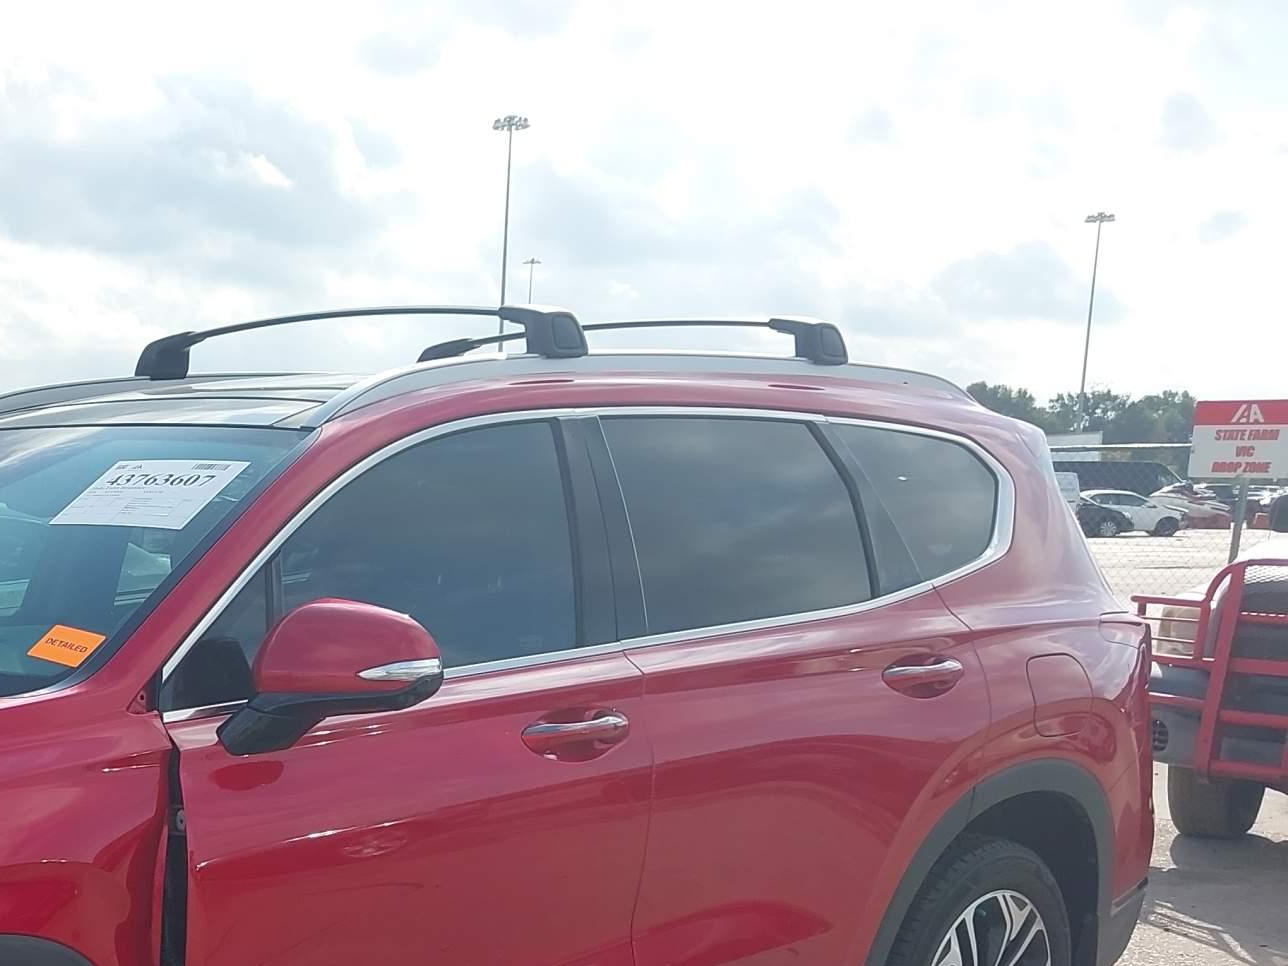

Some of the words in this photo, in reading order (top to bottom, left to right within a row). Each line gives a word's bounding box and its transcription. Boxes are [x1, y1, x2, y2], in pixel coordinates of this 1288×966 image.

[1214, 429, 1247, 441] STATE
[1211, 461, 1242, 473] DROP
[1242, 461, 1272, 473] ZONE
[106, 473, 217, 487] 43763607
[44, 637, 89, 653] DETAILED
